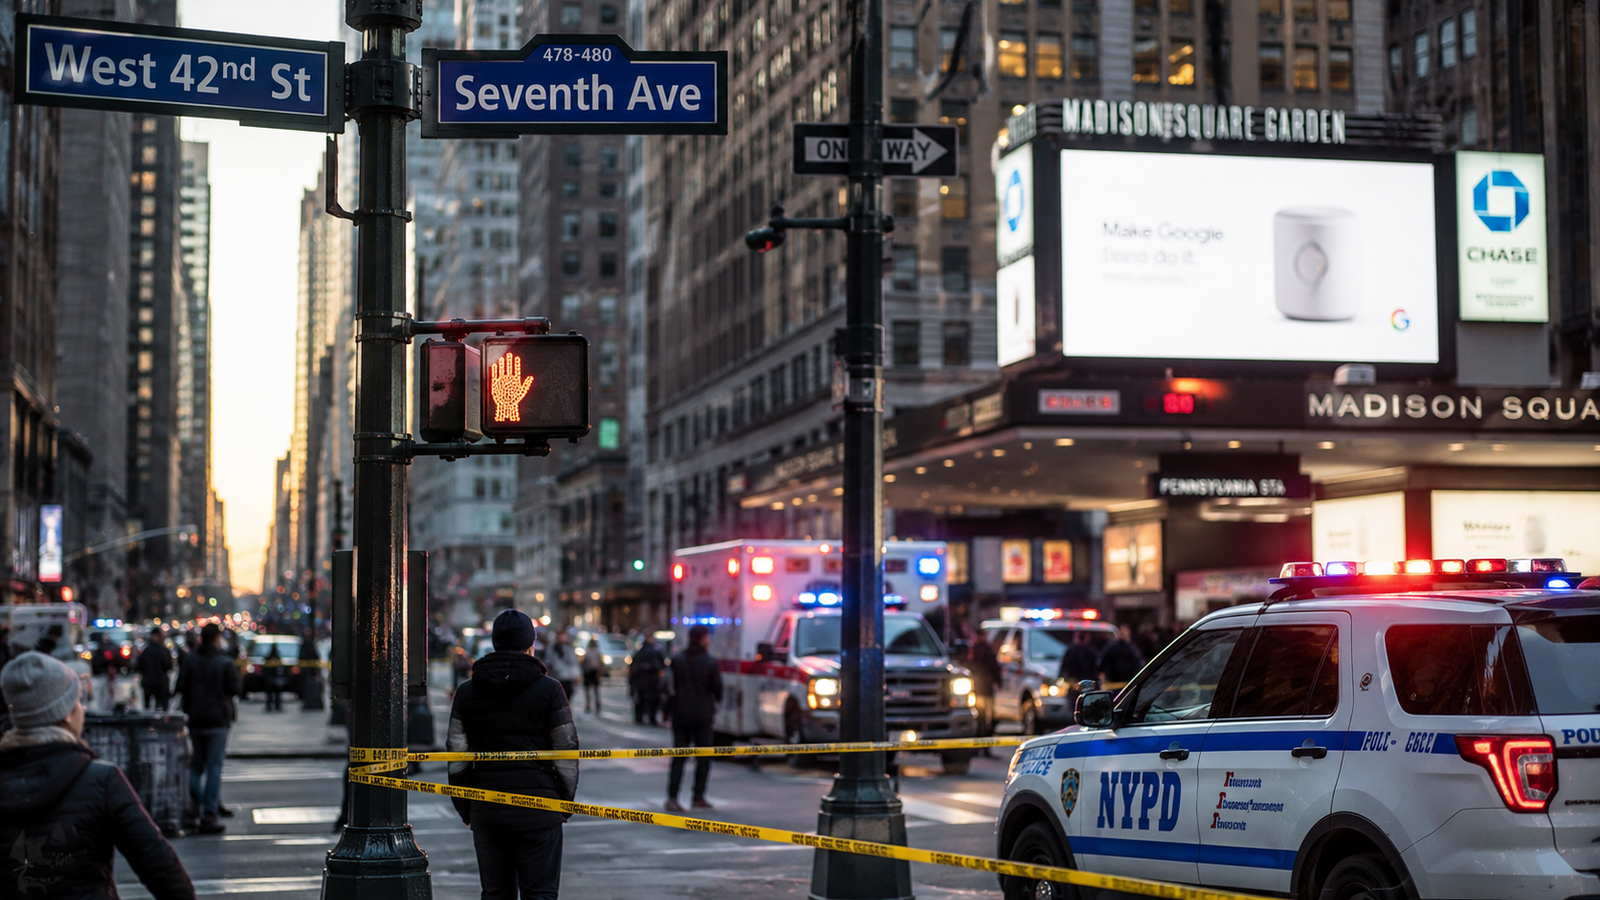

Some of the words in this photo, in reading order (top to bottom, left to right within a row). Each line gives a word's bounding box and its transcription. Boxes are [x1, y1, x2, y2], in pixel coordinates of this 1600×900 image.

[543, 47, 612, 62] 478-480
[44, 42, 156, 89] West
[169, 53, 256, 95] 42nd
[270, 63, 311, 102] St
[455, 74, 614, 111] Seventh
[627, 76, 701, 111] Ave
[1062, 97, 1165, 137] MADISON
[1172, 103, 1257, 141] SQUARE
[1264, 106, 1346, 144] GARDEN
[816, 139, 848, 160] ON
[886, 141, 932, 161] WAY
[1466, 246, 1538, 265] CHASE
[1308, 393, 1482, 419] MADISON
[1502, 396, 1600, 420] SQUA
[1097, 771, 1182, 832] NYPD
